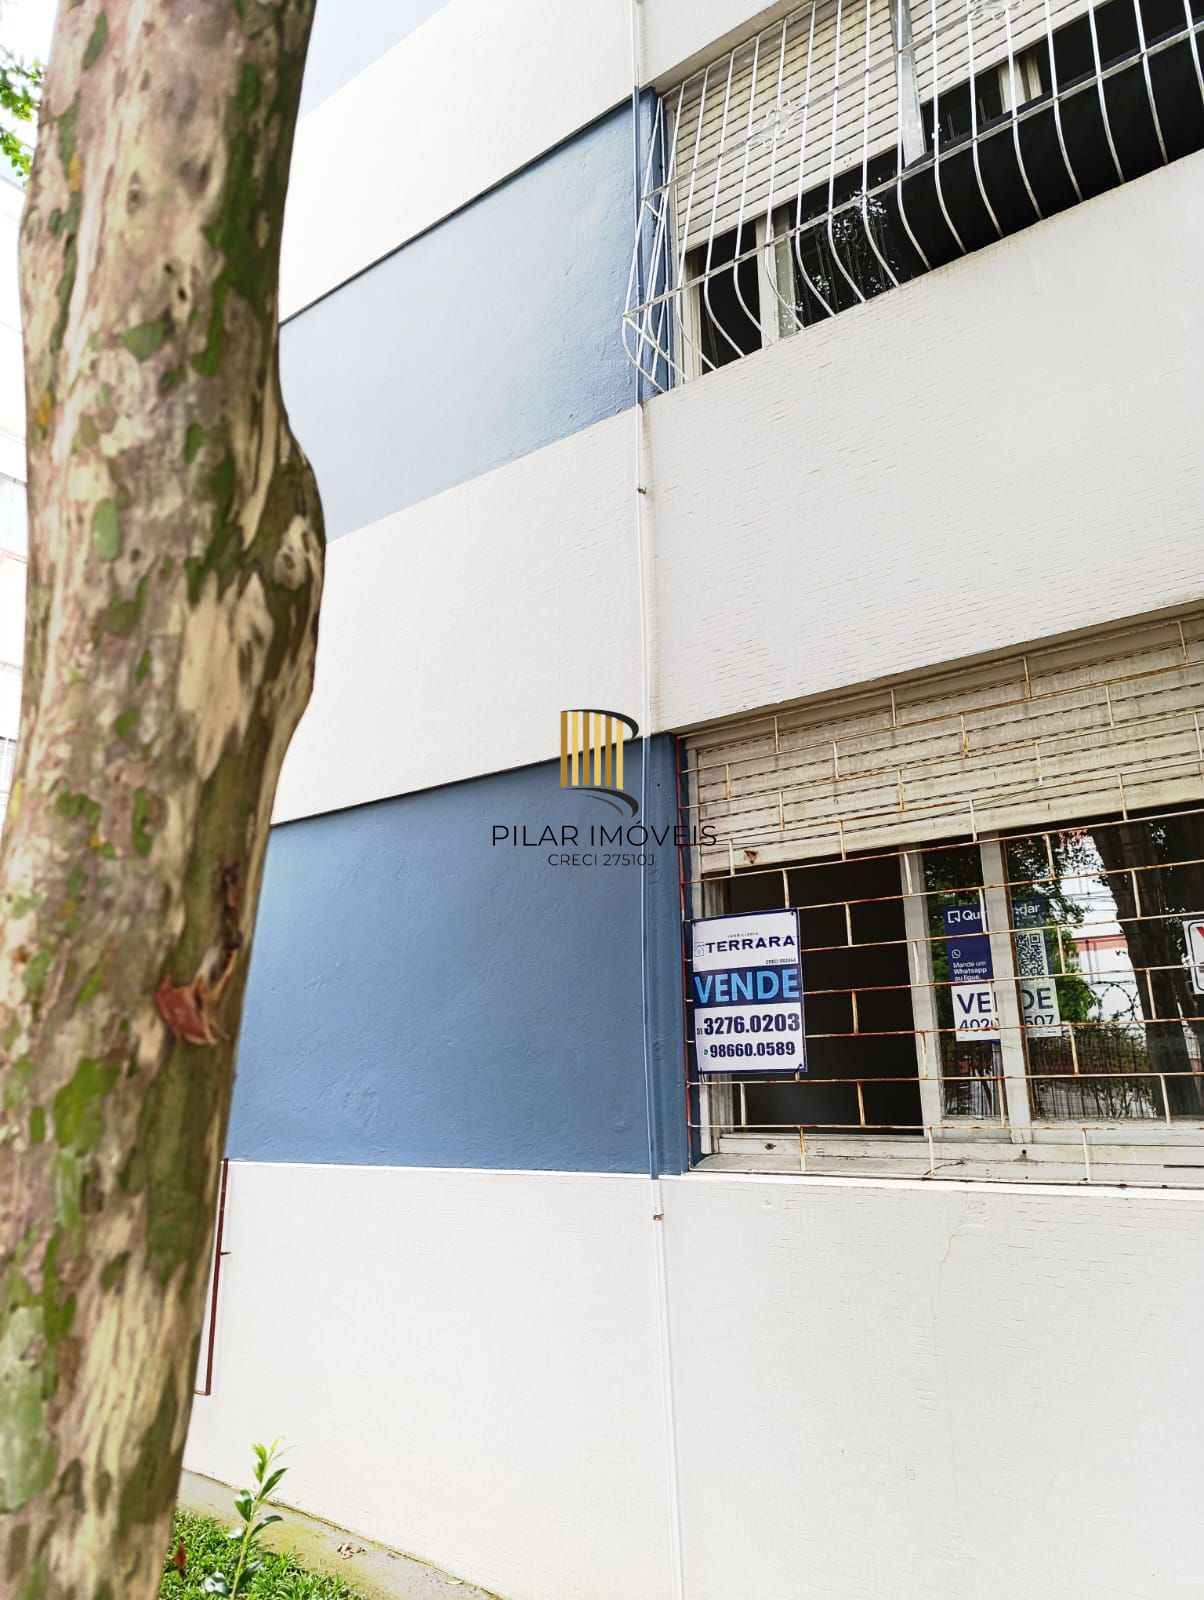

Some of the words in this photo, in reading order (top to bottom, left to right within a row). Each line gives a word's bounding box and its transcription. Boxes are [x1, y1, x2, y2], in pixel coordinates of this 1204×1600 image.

[705, 935, 795, 954] TERRARA
[694, 968, 800, 1004] VENDE
[957, 987, 1054, 1015] VEDE
[703, 1012, 800, 1036] 3276.0203
[709, 1041, 796, 1058] 98660.0589
